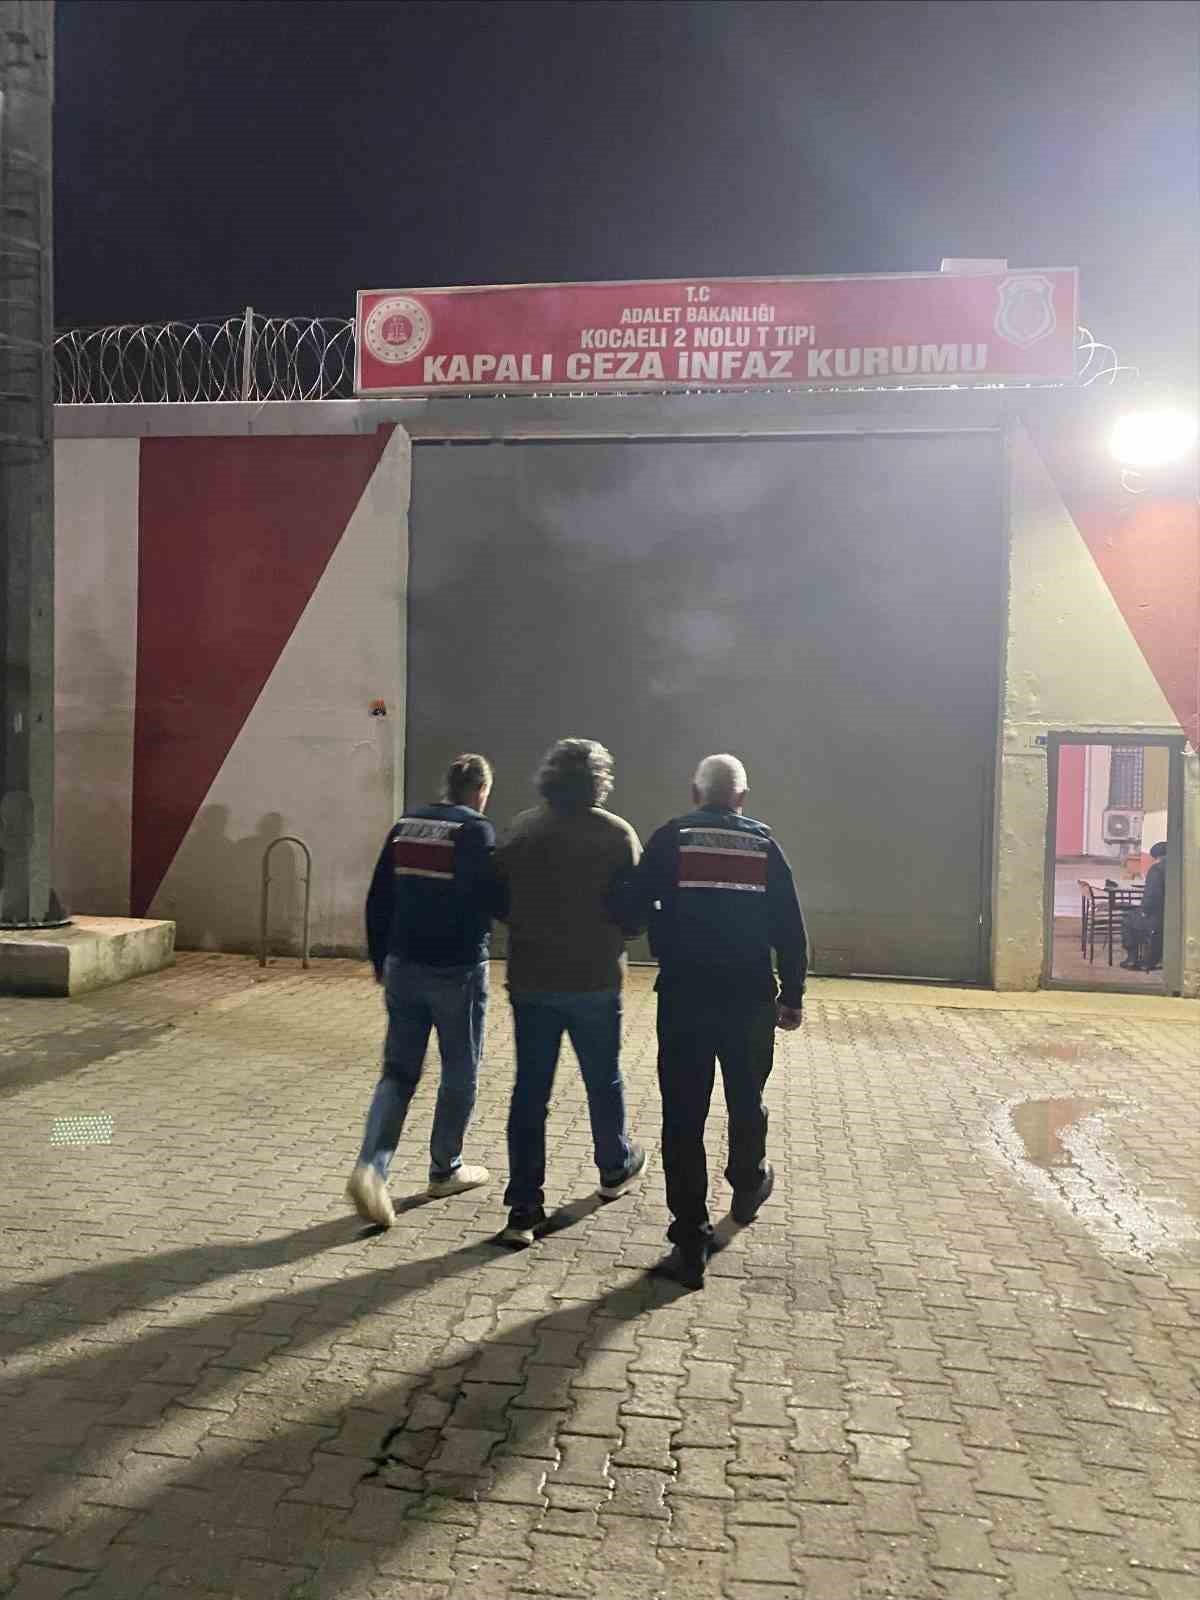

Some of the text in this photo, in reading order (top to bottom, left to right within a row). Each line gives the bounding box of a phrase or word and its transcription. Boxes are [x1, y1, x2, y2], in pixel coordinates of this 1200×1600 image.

[685, 286, 710, 302] T.C
[620, 303, 775, 324] ADALET BAKANLIĞI
[673, 327, 687, 347] 2
[694, 326, 750, 347] NOLU
[757, 326, 769, 346] T
[423, 354, 552, 383] KAPALI
[566, 351, 664, 380] CEZA
[807, 344, 987, 377] KURUMU
